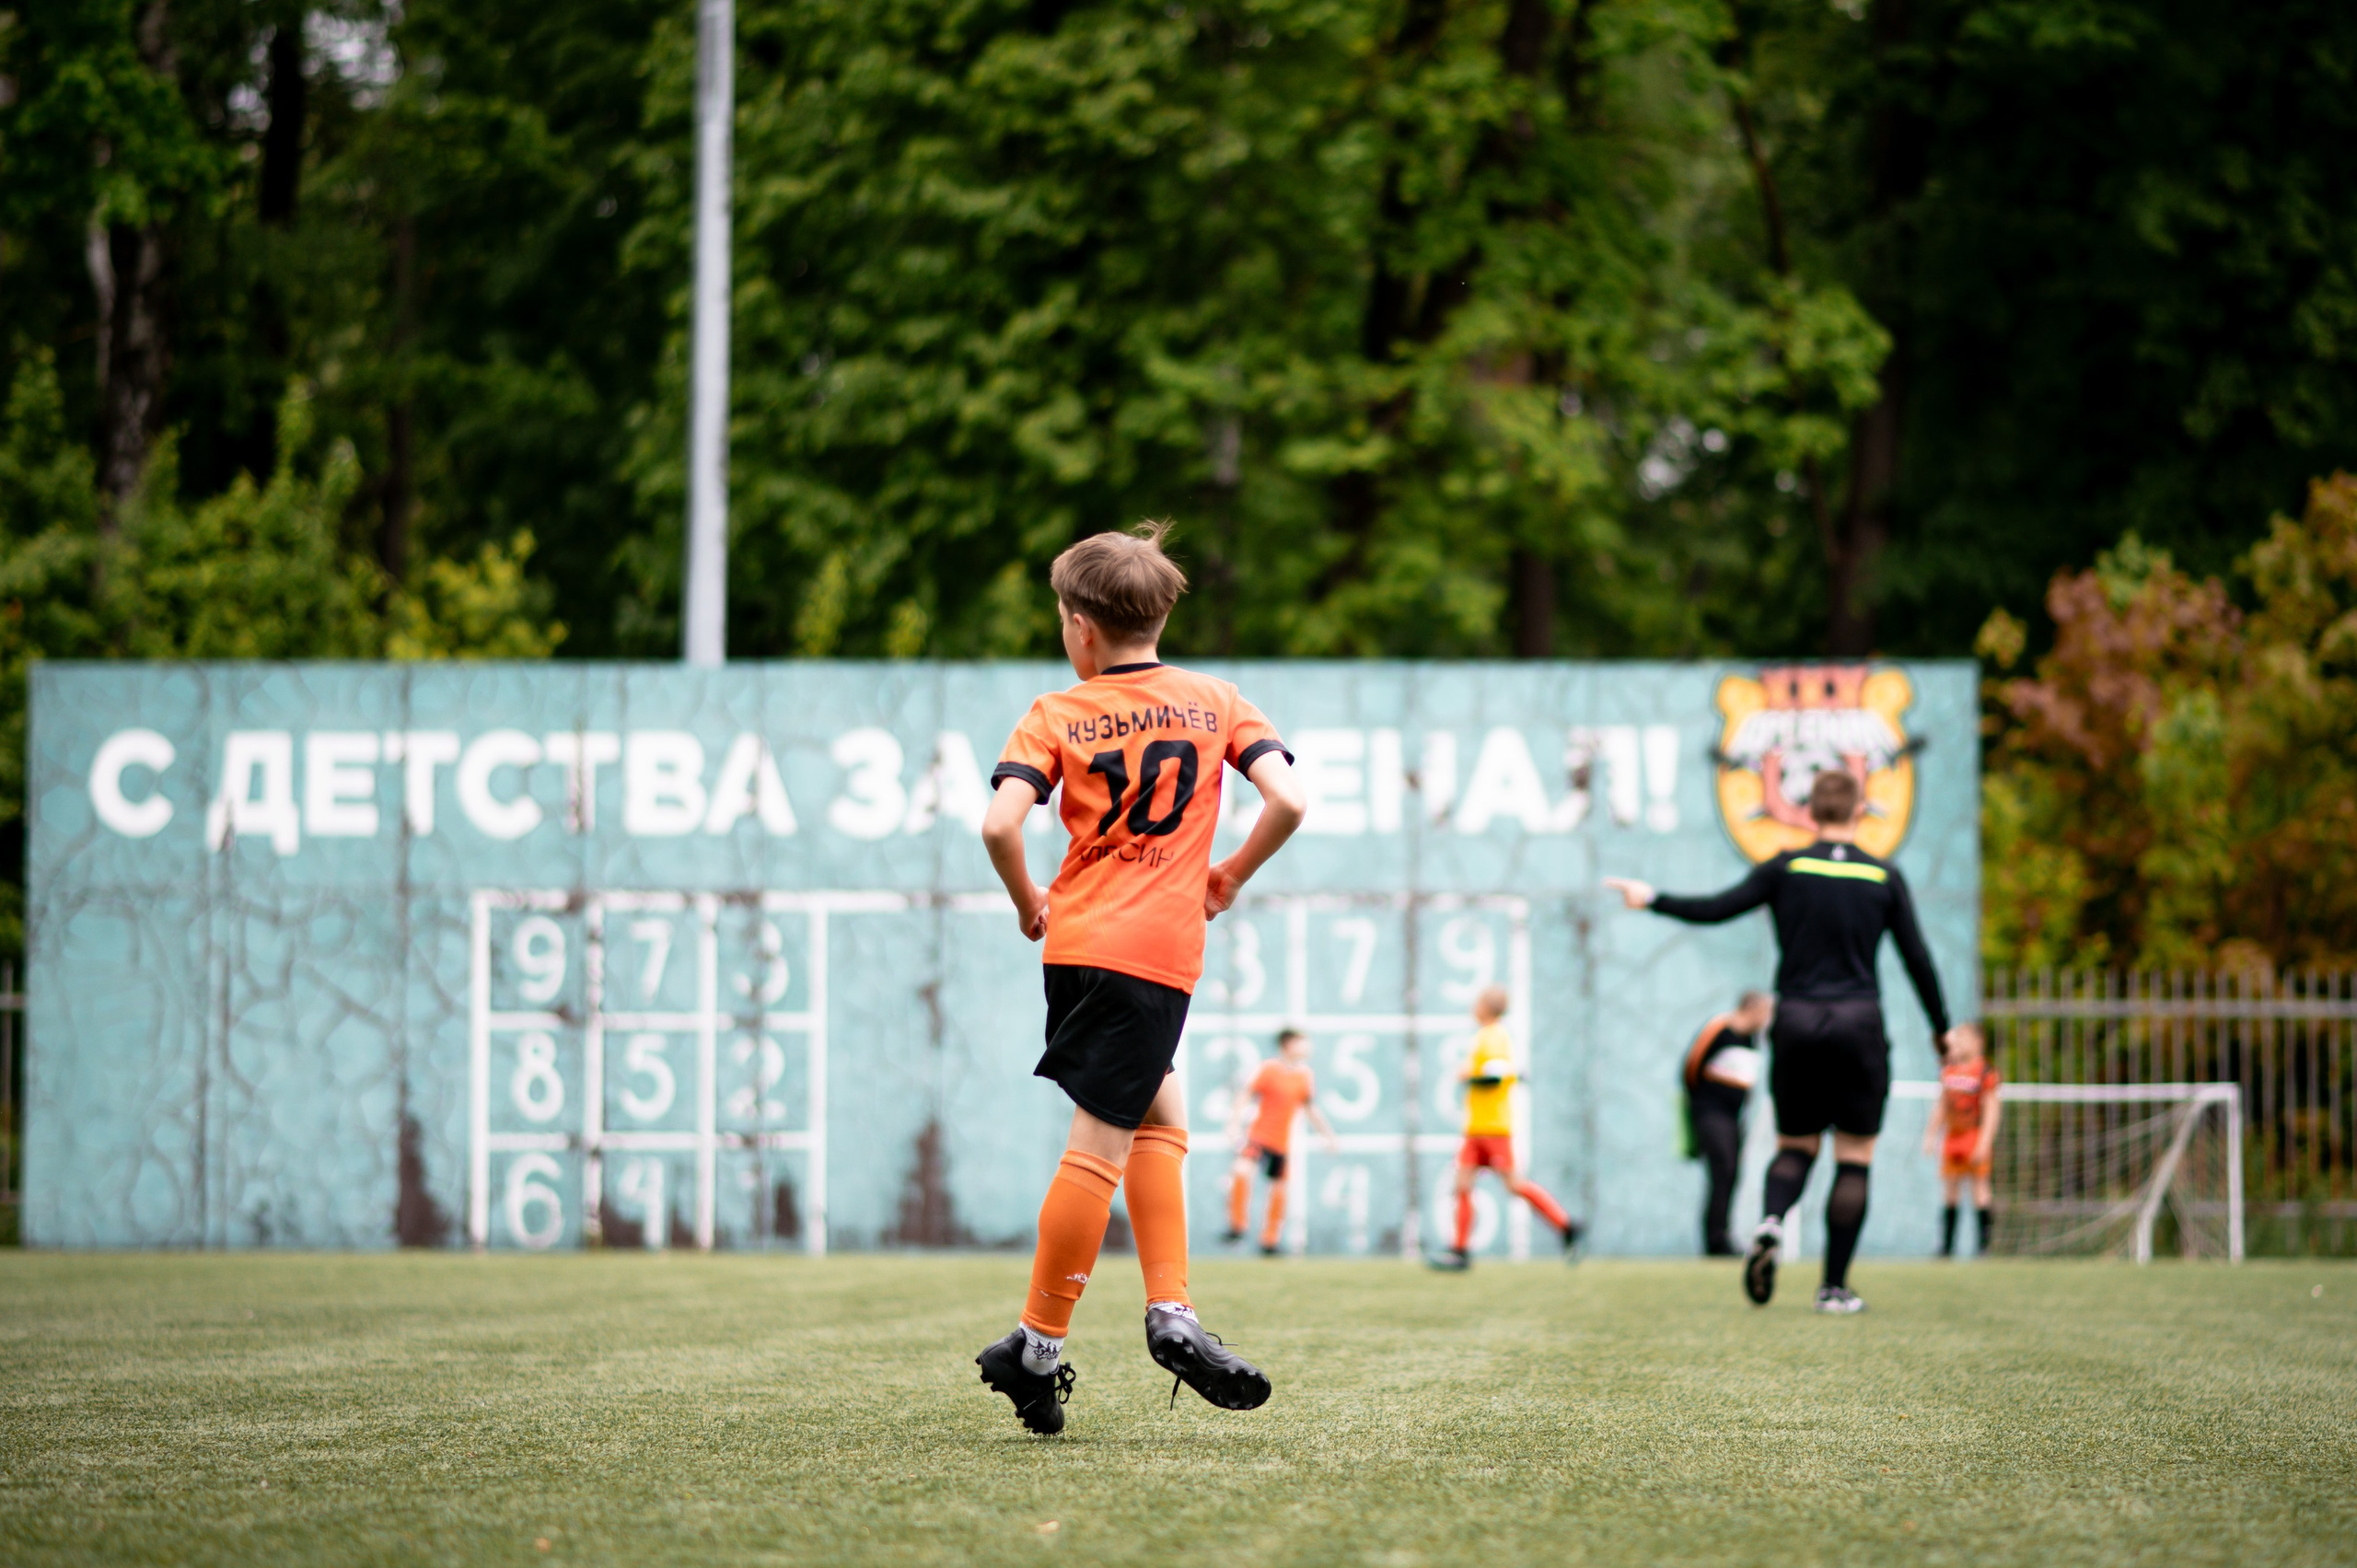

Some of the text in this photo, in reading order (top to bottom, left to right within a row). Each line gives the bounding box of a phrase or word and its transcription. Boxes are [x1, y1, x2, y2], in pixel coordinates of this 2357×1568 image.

[1067, 701, 1218, 744] КУЗЬМИЧЁВ
[89, 728, 176, 839] С
[206, 728, 798, 855] ДЕТСТВА
[827, 727, 992, 841] ЗА
[1029, 726, 1680, 836] ЕНАЛ!
[1087, 740, 1199, 836] 10
[513, 917, 566, 1003] 9
[630, 921, 672, 1004] 7
[1209, 917, 1496, 1007] 3 7 9
[511, 1031, 565, 1122] 8
[621, 1032, 676, 1122] 5
[1321, 1034, 1380, 1122] 5
[506, 1152, 563, 1249] 6
[620, 1157, 665, 1250] 4
[1322, 1164, 1369, 1250] 4
